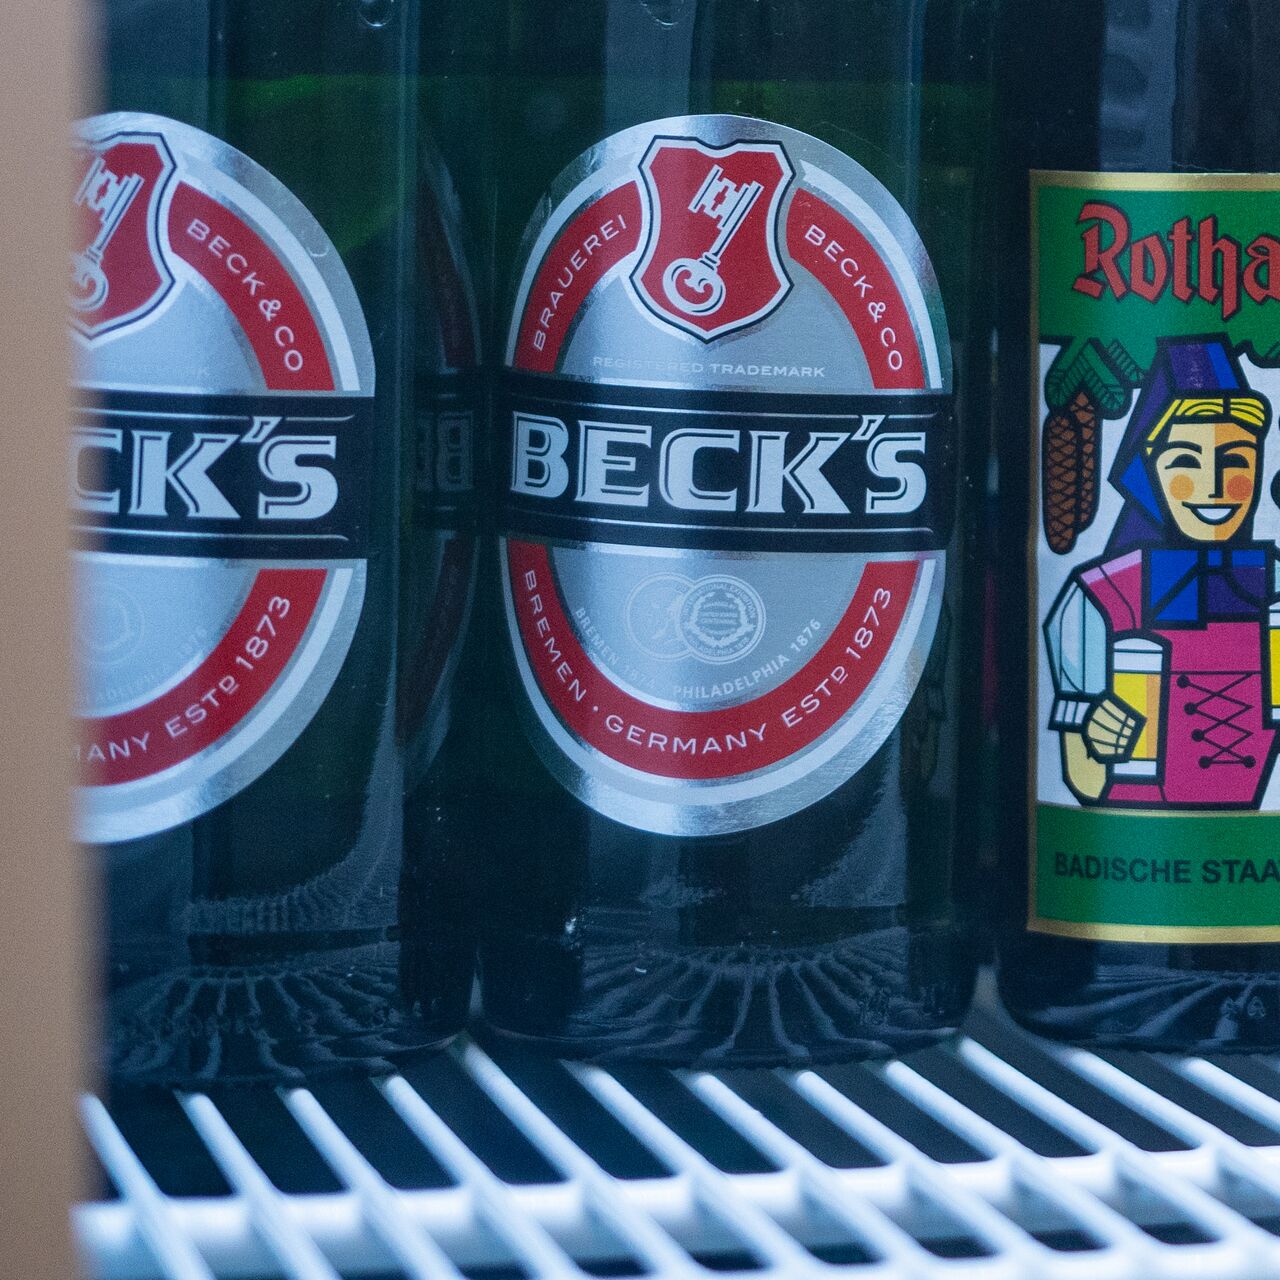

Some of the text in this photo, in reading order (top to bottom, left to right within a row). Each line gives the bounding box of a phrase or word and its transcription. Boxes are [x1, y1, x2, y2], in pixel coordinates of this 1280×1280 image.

[533, 214, 627, 352] BRAUEREI
[592, 356, 825, 378] REGISTERED TRADEMARK
[508, 411, 928, 515] BECK'S
[235, 596, 291, 670] 1873
[525, 570, 587, 702] BREMEN
[604, 713, 767, 756] GERMANY
[846, 587, 892, 660] 1873
[575, 607, 620, 666] BREMEN
[672, 653, 791, 699] PHILADELPHIA
[790, 618, 822, 652] 1876
[1054, 850, 1193, 885] BADISCHE
